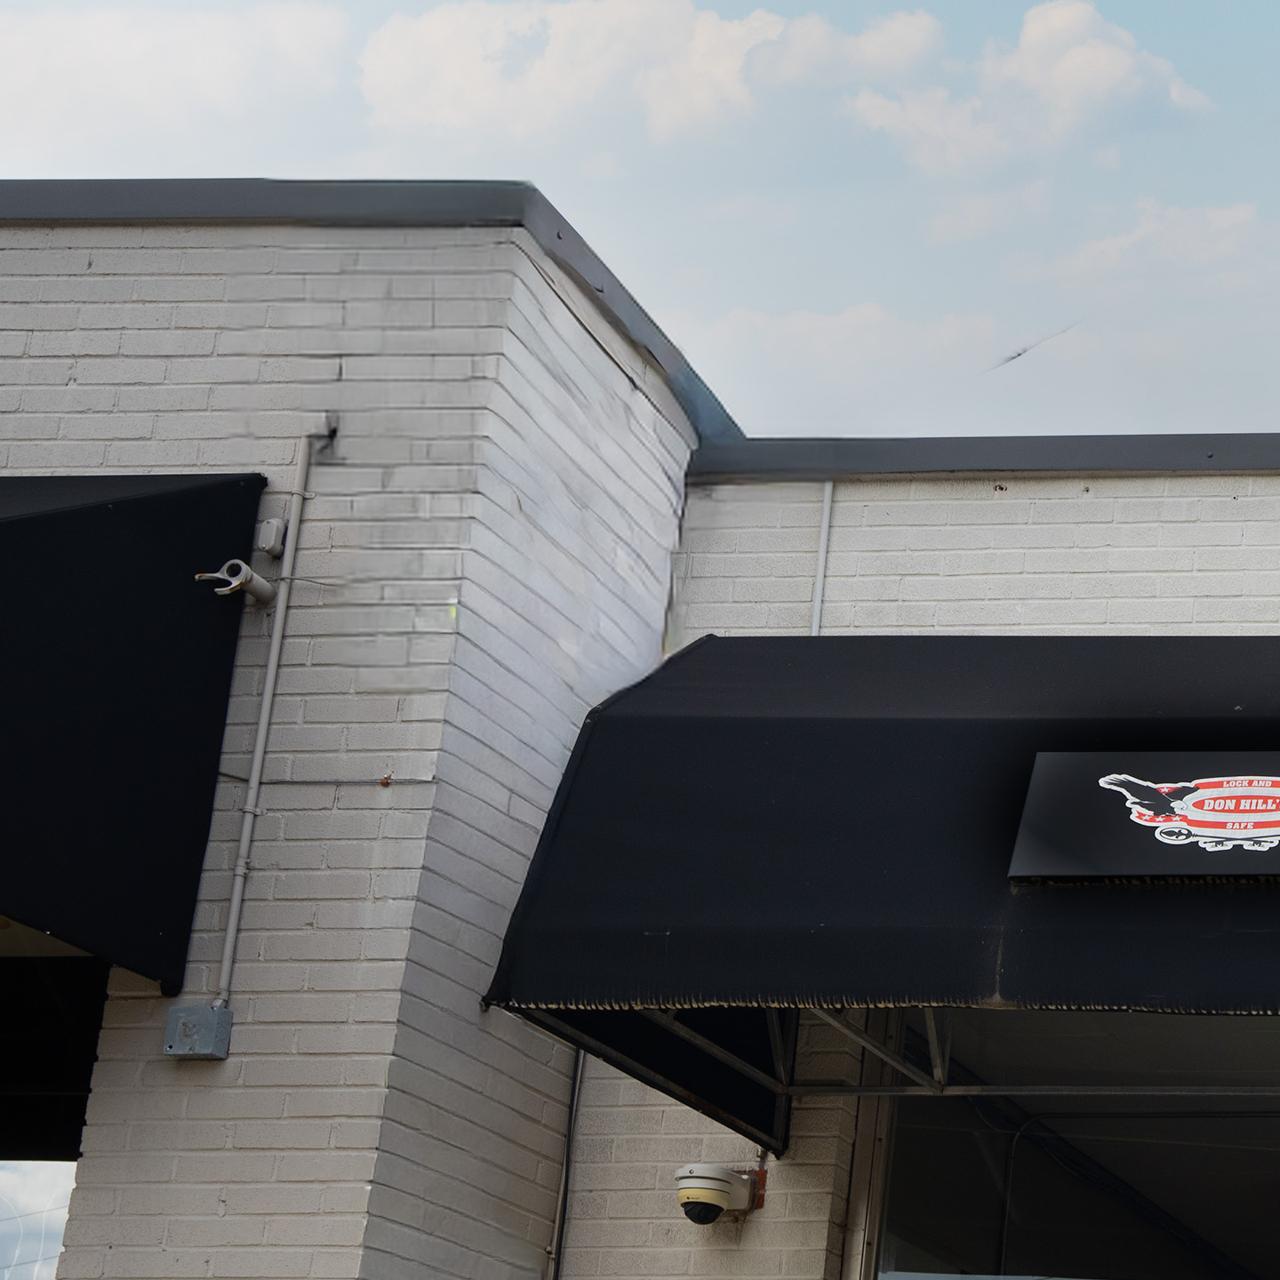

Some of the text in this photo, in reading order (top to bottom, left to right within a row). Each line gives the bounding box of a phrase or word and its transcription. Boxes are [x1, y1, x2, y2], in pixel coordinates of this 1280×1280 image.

[1251, 780, 1272, 788] AND
[1203, 799, 1237, 810] DON
[1225, 822, 1255, 830] SAFE
